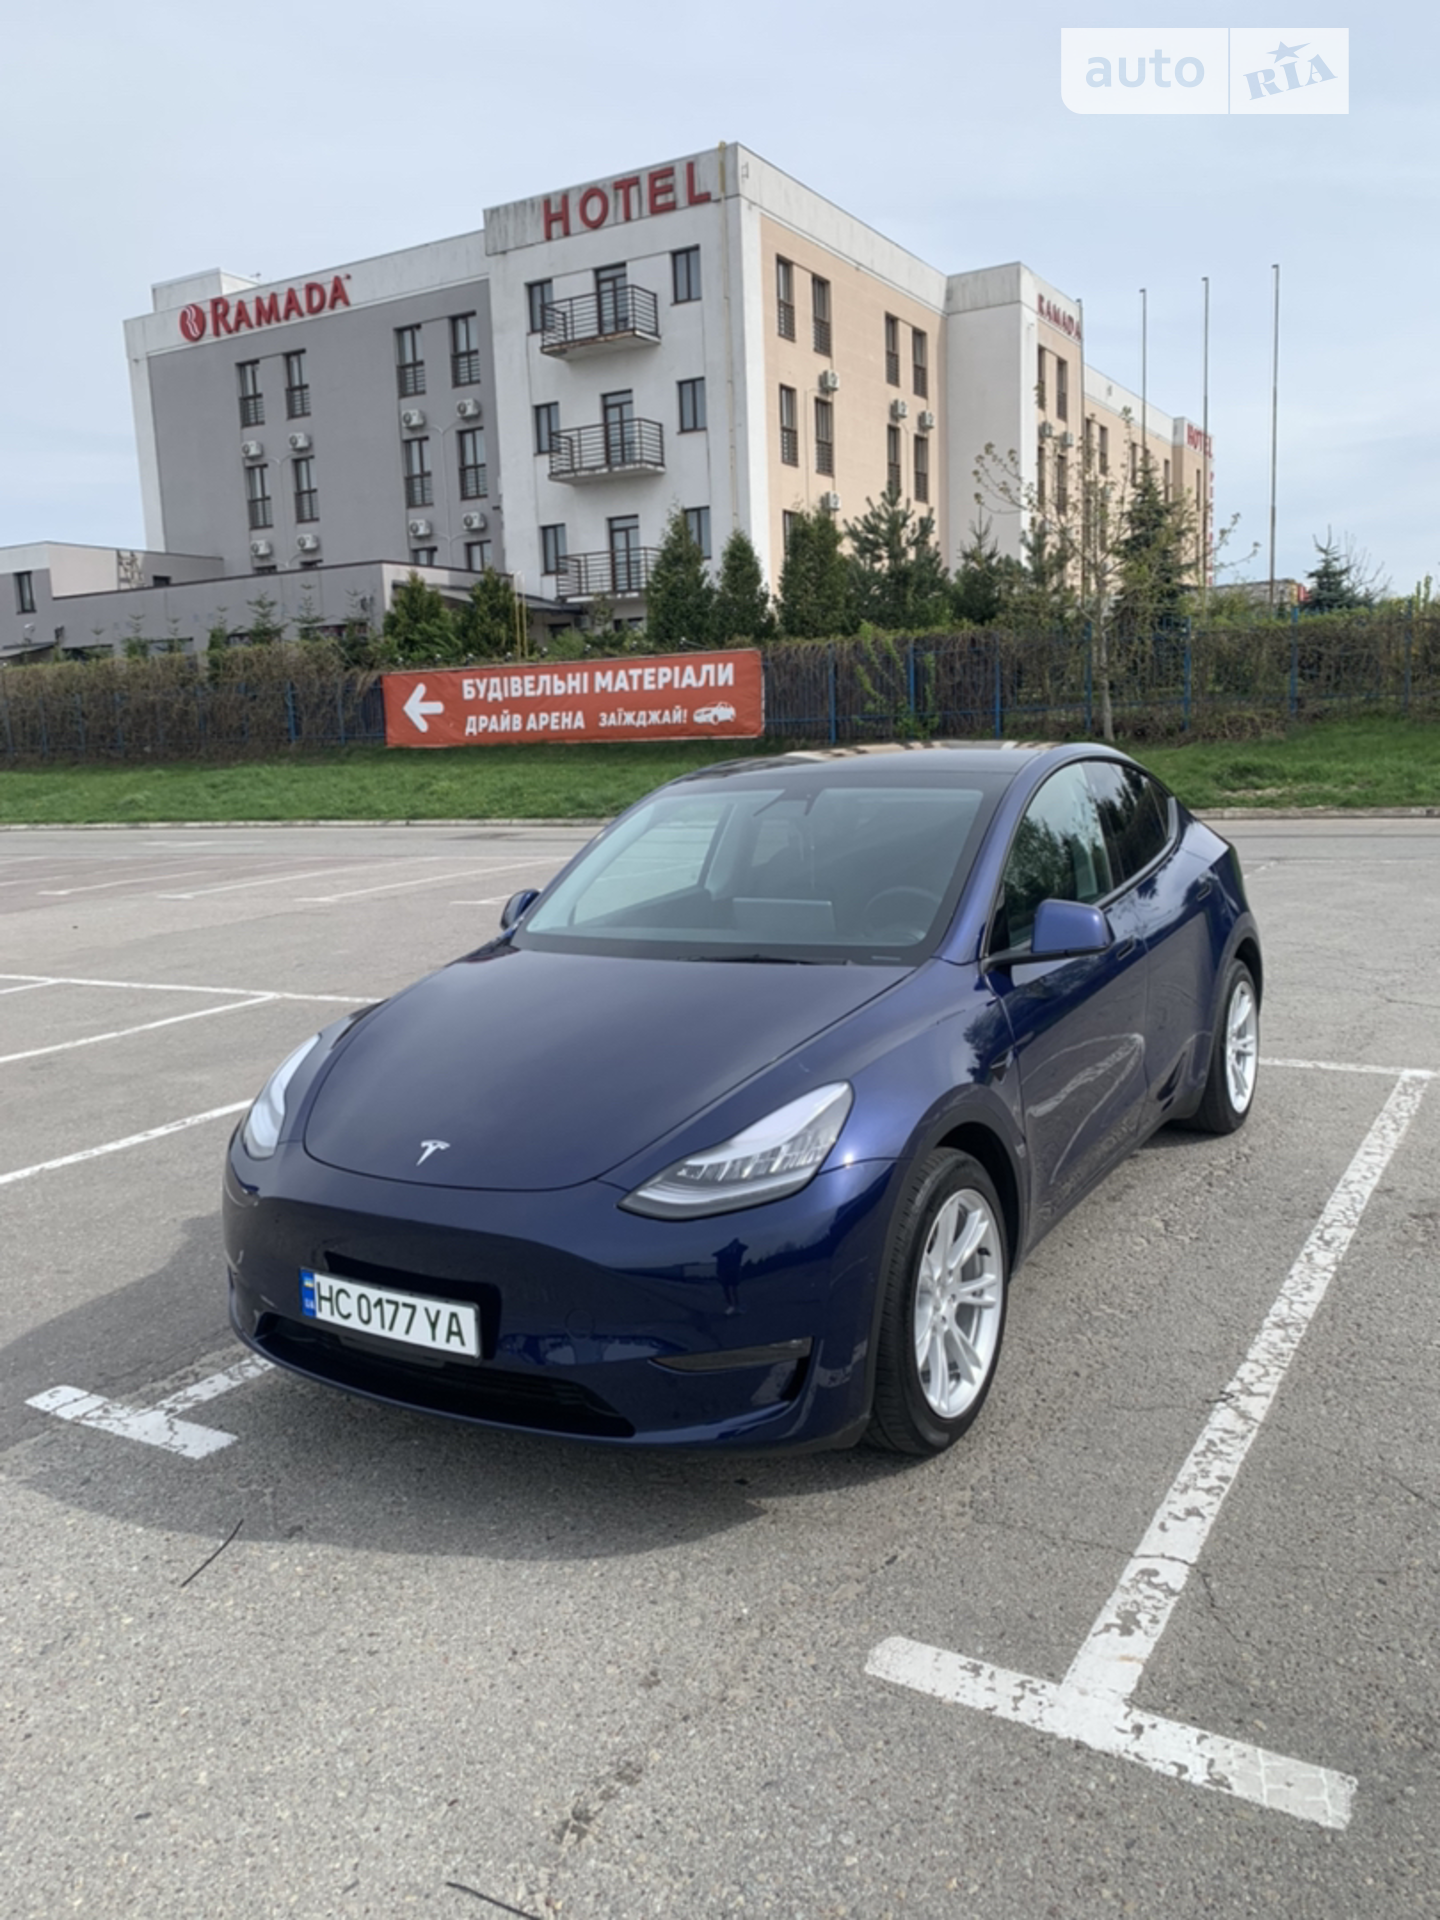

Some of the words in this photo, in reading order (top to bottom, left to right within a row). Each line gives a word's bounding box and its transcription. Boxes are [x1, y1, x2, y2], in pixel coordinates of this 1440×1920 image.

[543, 161, 712, 242] HOTEL
[210, 275, 351, 338] RAMADA
[462, 671, 589, 703] БУДІВЕЛЬНІ
[594, 662, 734, 694] МАТЕРІАЛИ
[465, 709, 523, 737] ДРАЙВ
[526, 710, 585, 732] АРЕНА
[598, 705, 688, 728] ЗАЇЖДЖАЙ!
